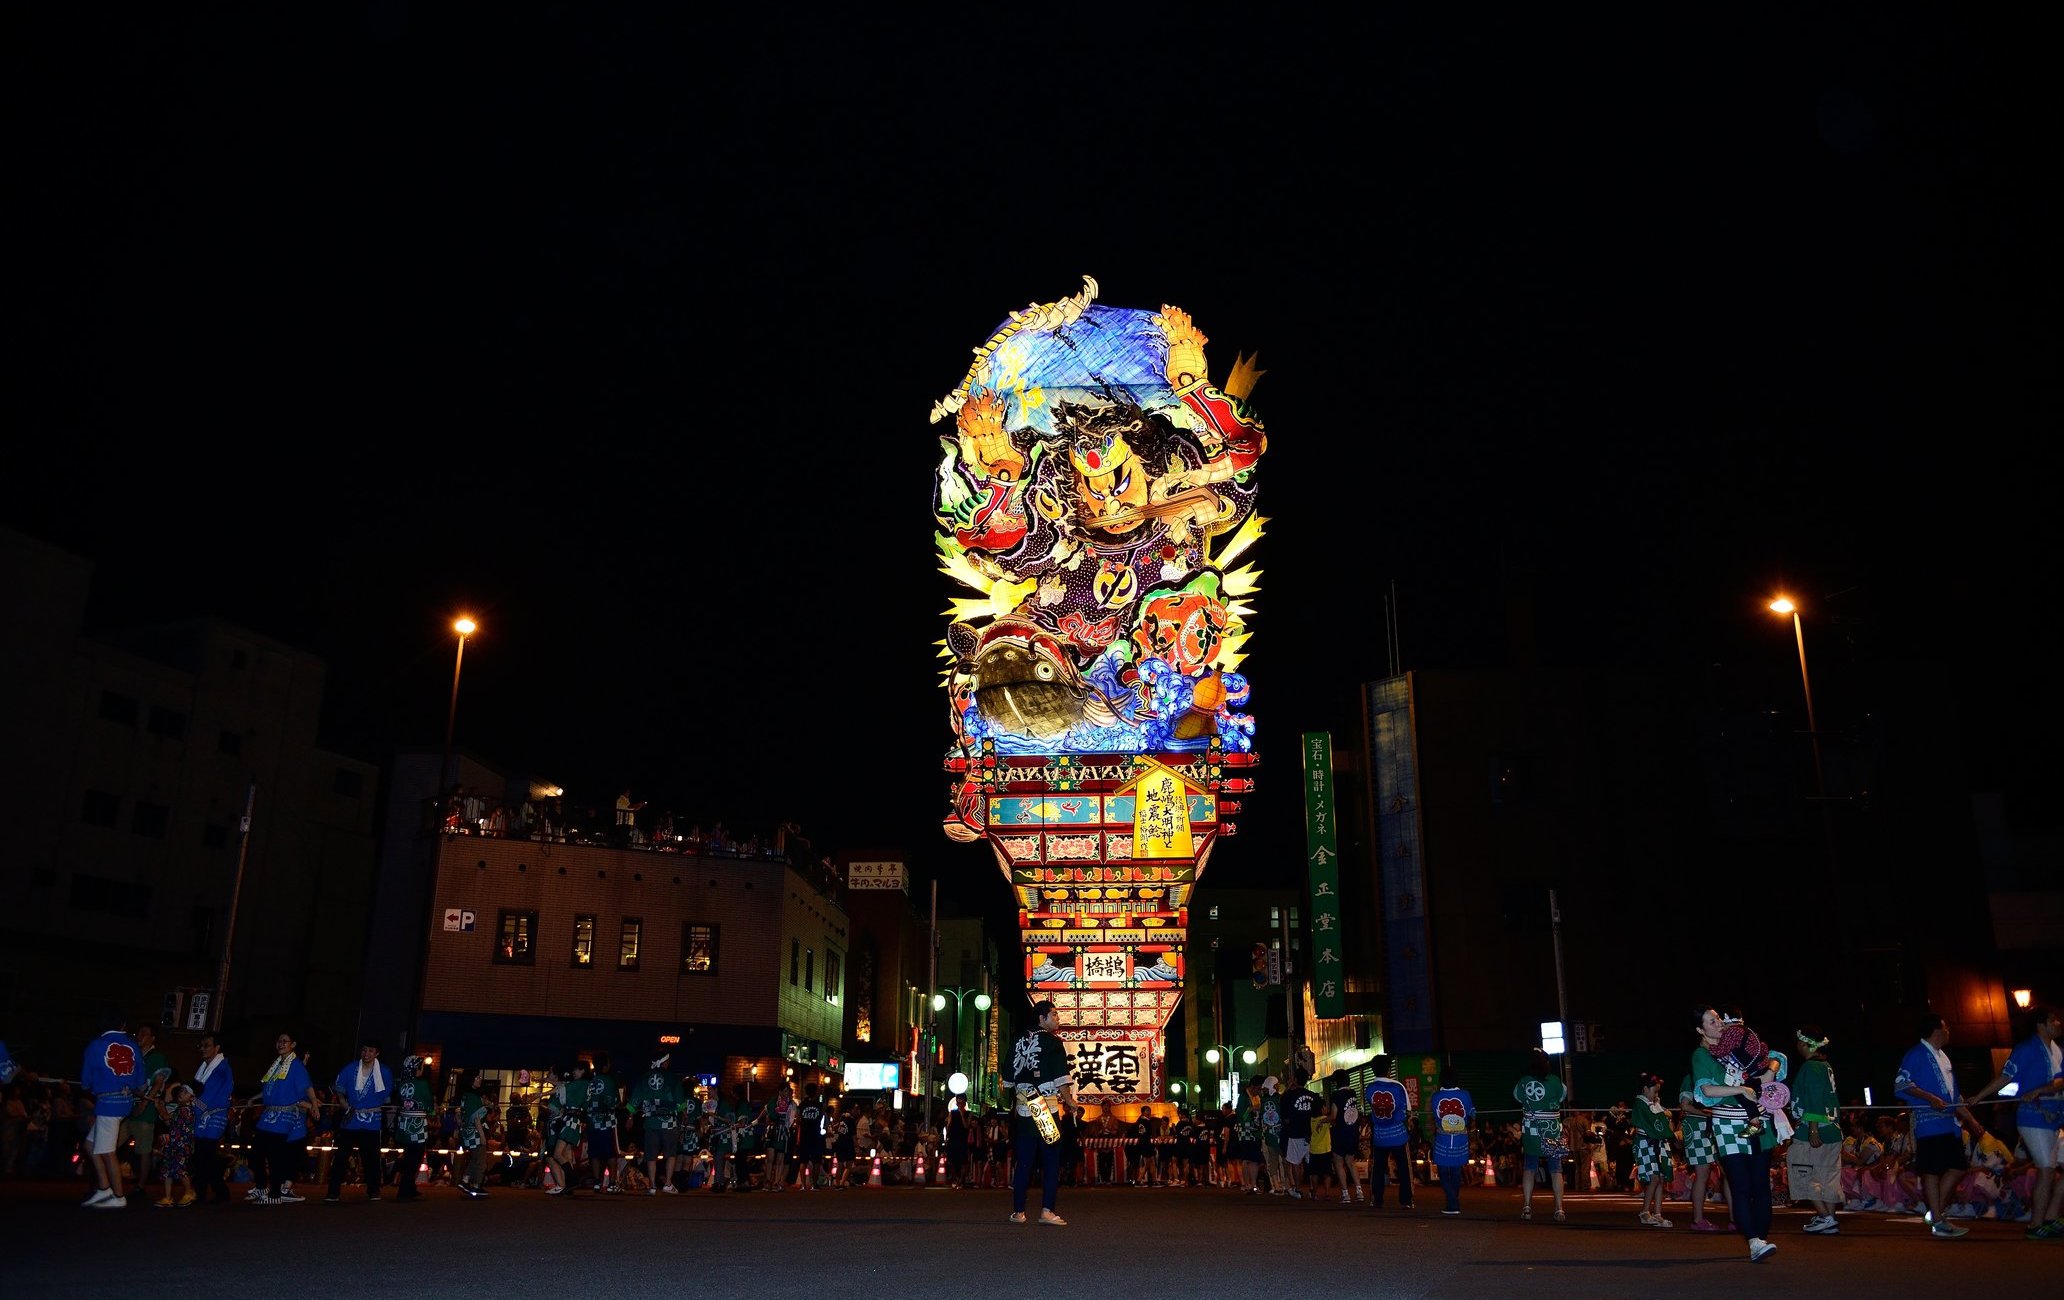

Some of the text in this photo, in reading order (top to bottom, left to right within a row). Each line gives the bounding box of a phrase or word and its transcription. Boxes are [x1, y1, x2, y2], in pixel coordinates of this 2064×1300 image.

[1160, 777, 1175, 849] 鹿嶋大明神と
[1311, 738, 1328, 835] 宝石・時計・メガネ
[461, 911, 475, 930] P
[1310, 845, 1340, 998] 金正堂本店
